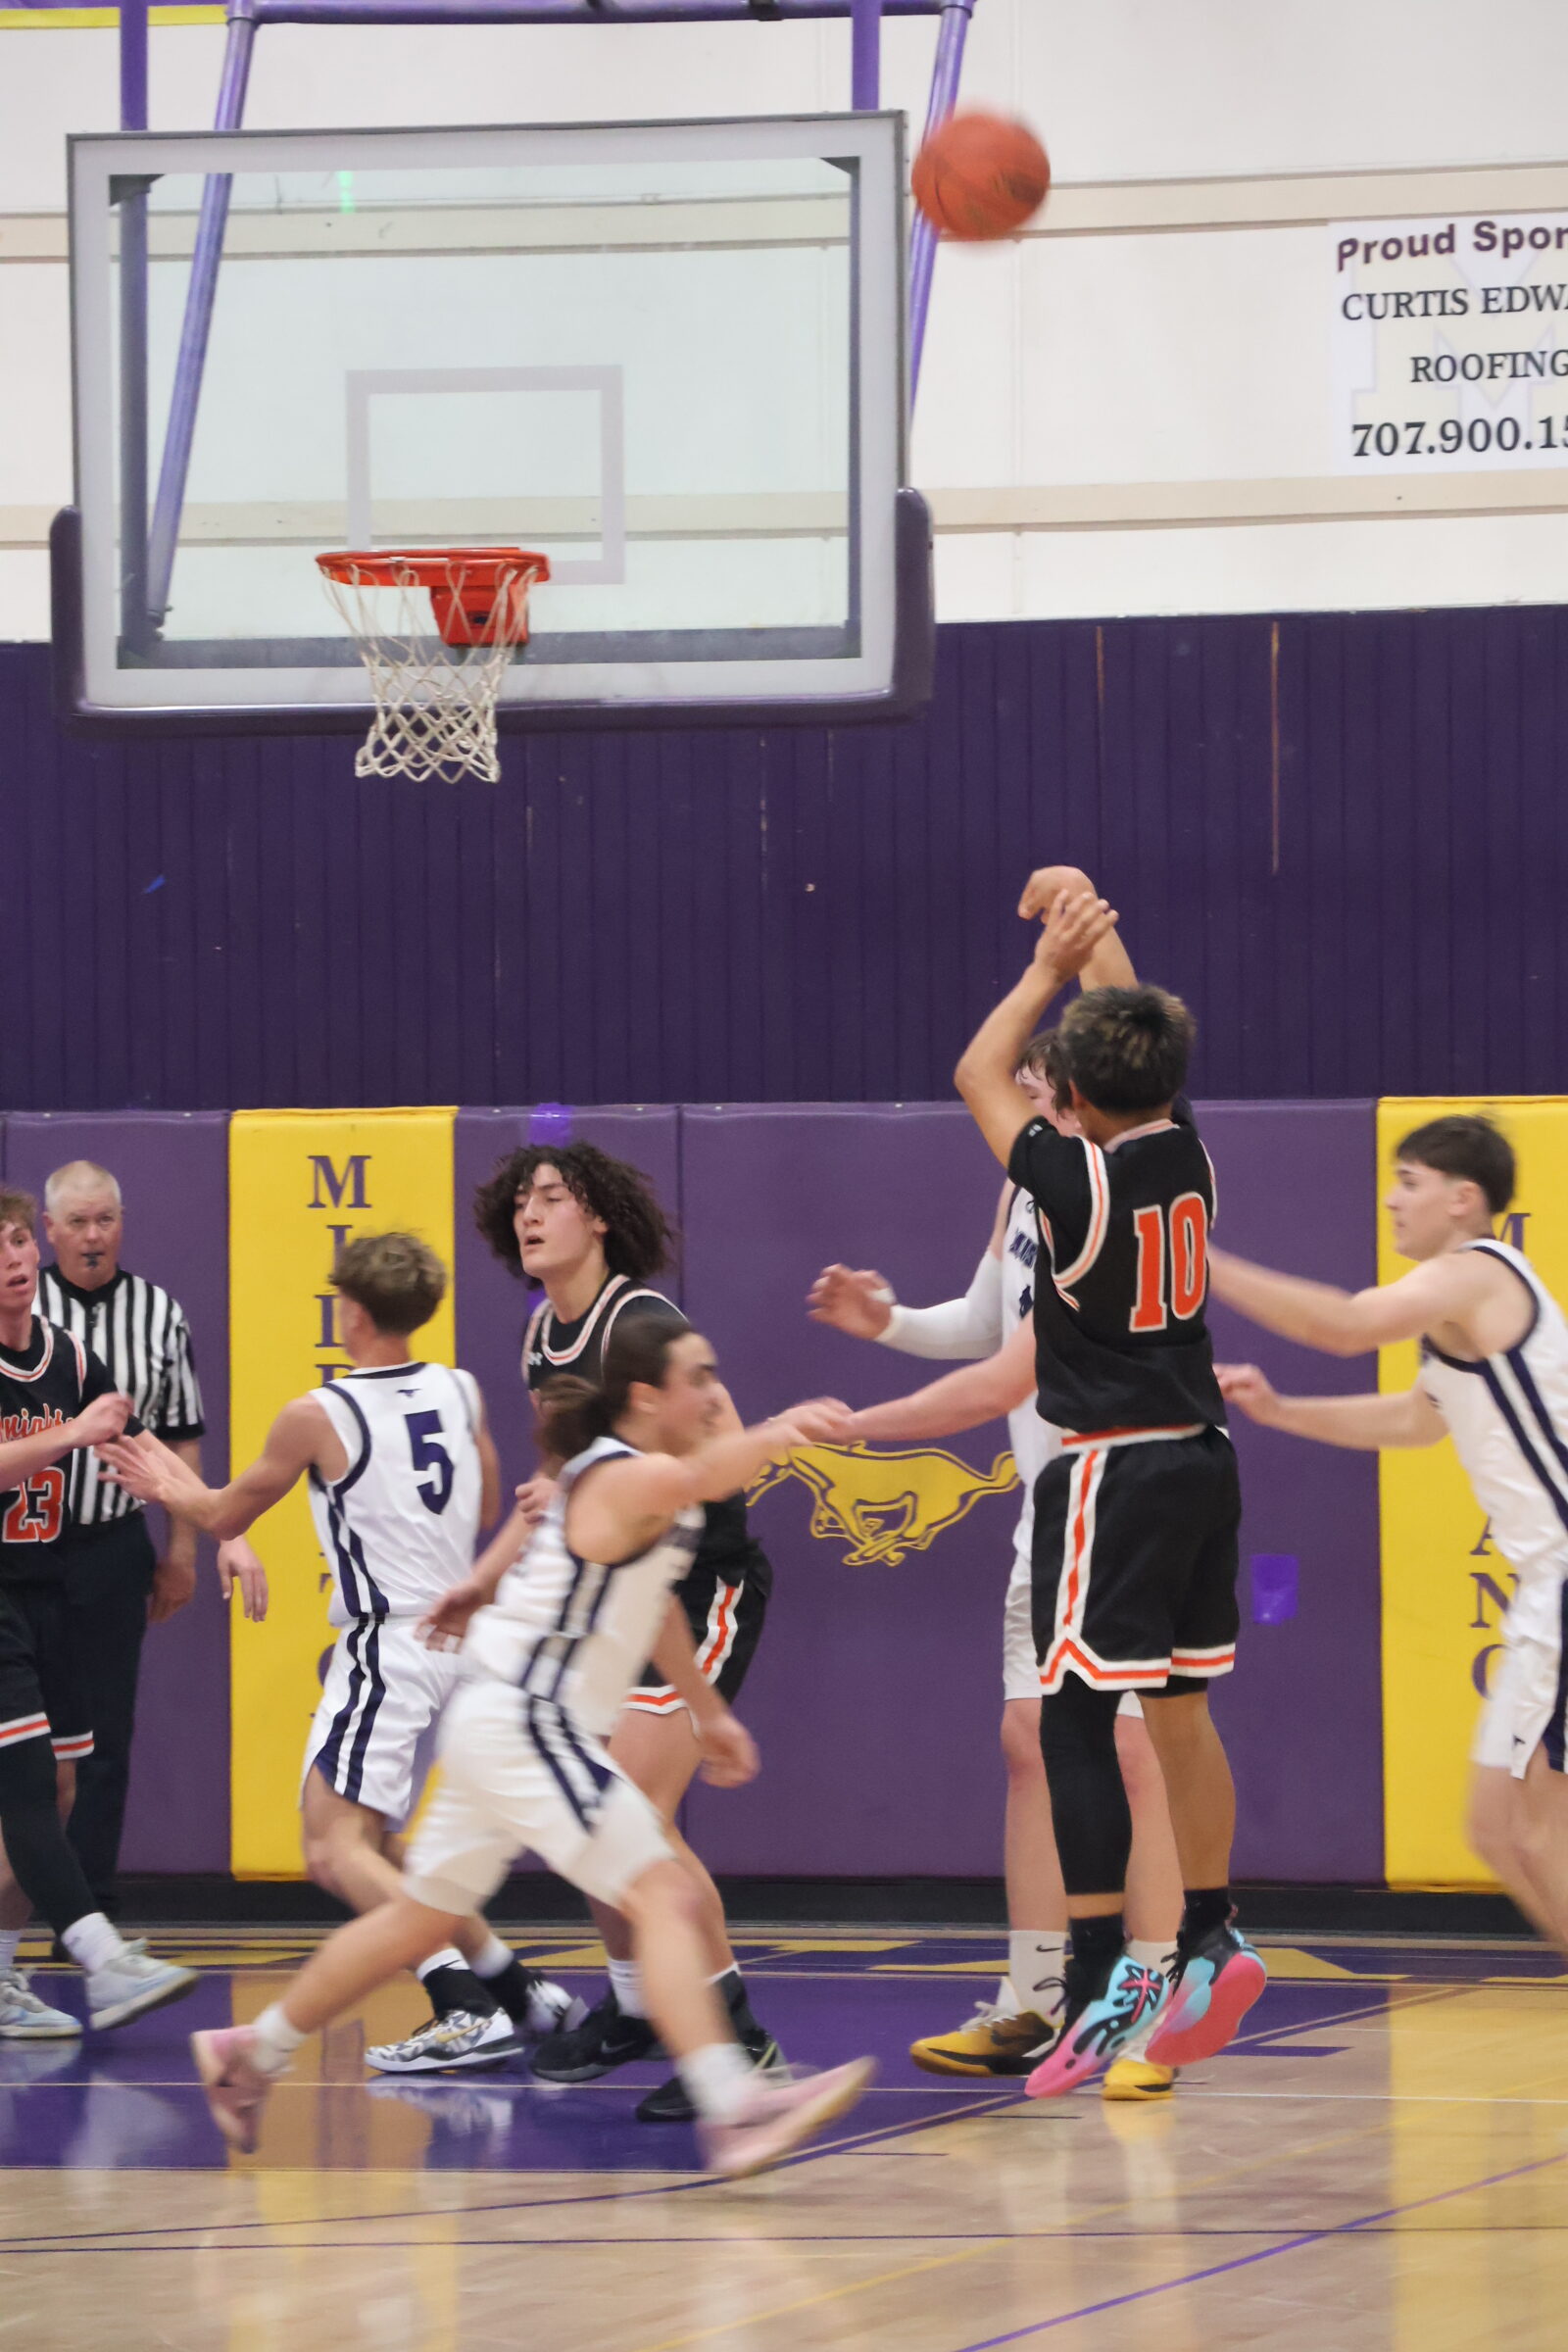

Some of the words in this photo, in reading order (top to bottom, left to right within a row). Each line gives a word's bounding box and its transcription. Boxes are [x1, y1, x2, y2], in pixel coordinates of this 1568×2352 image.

[1338, 222, 1455, 272] Proud
[1342, 288, 1469, 320] CURTIS
[1481, 283, 1568, 315] EDW
[1410, 349, 1568, 383] ROOFING
[1352, 416, 1568, 458] 707.900.1
[1129, 1191, 1208, 1333] 10
[404, 1409, 455, 1515] 5
[2, 1466, 66, 1544] 23
